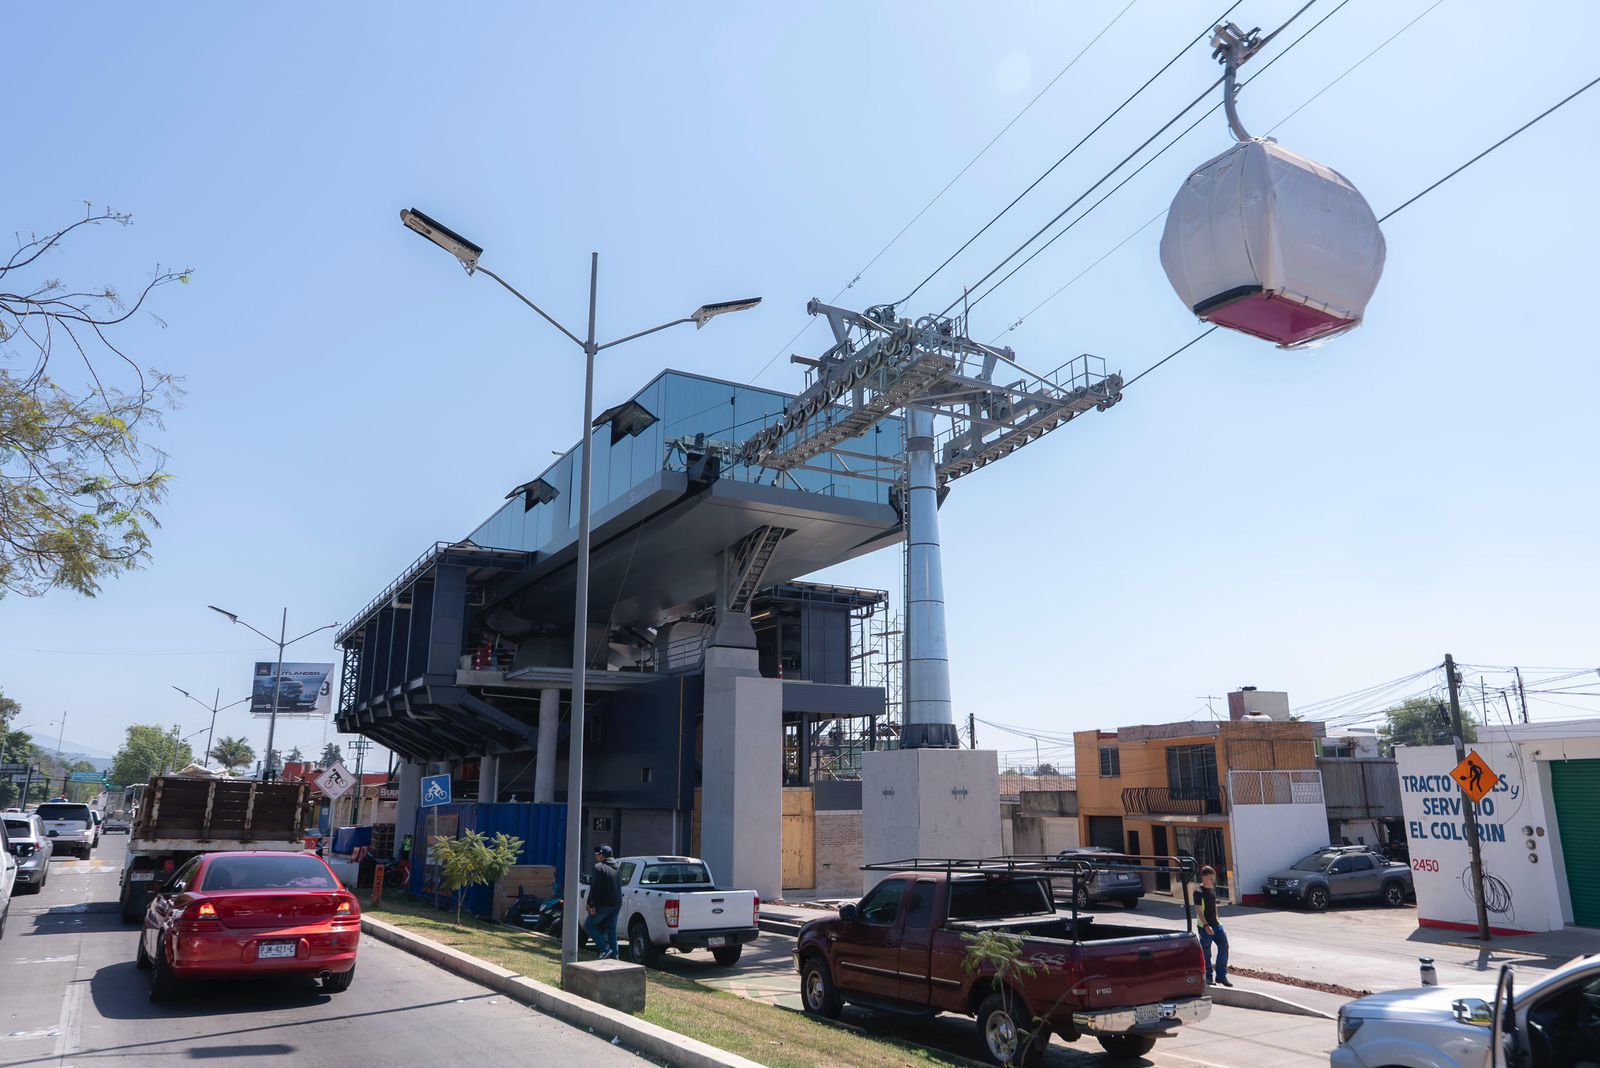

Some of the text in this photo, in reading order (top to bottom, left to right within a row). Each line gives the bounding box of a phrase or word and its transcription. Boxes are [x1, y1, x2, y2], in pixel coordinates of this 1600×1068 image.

[1402, 775, 1451, 792] TRACTO
[1423, 798, 1494, 816] SERVIO
[1409, 821, 1428, 839] EL
[1412, 859, 1439, 872] 2450
